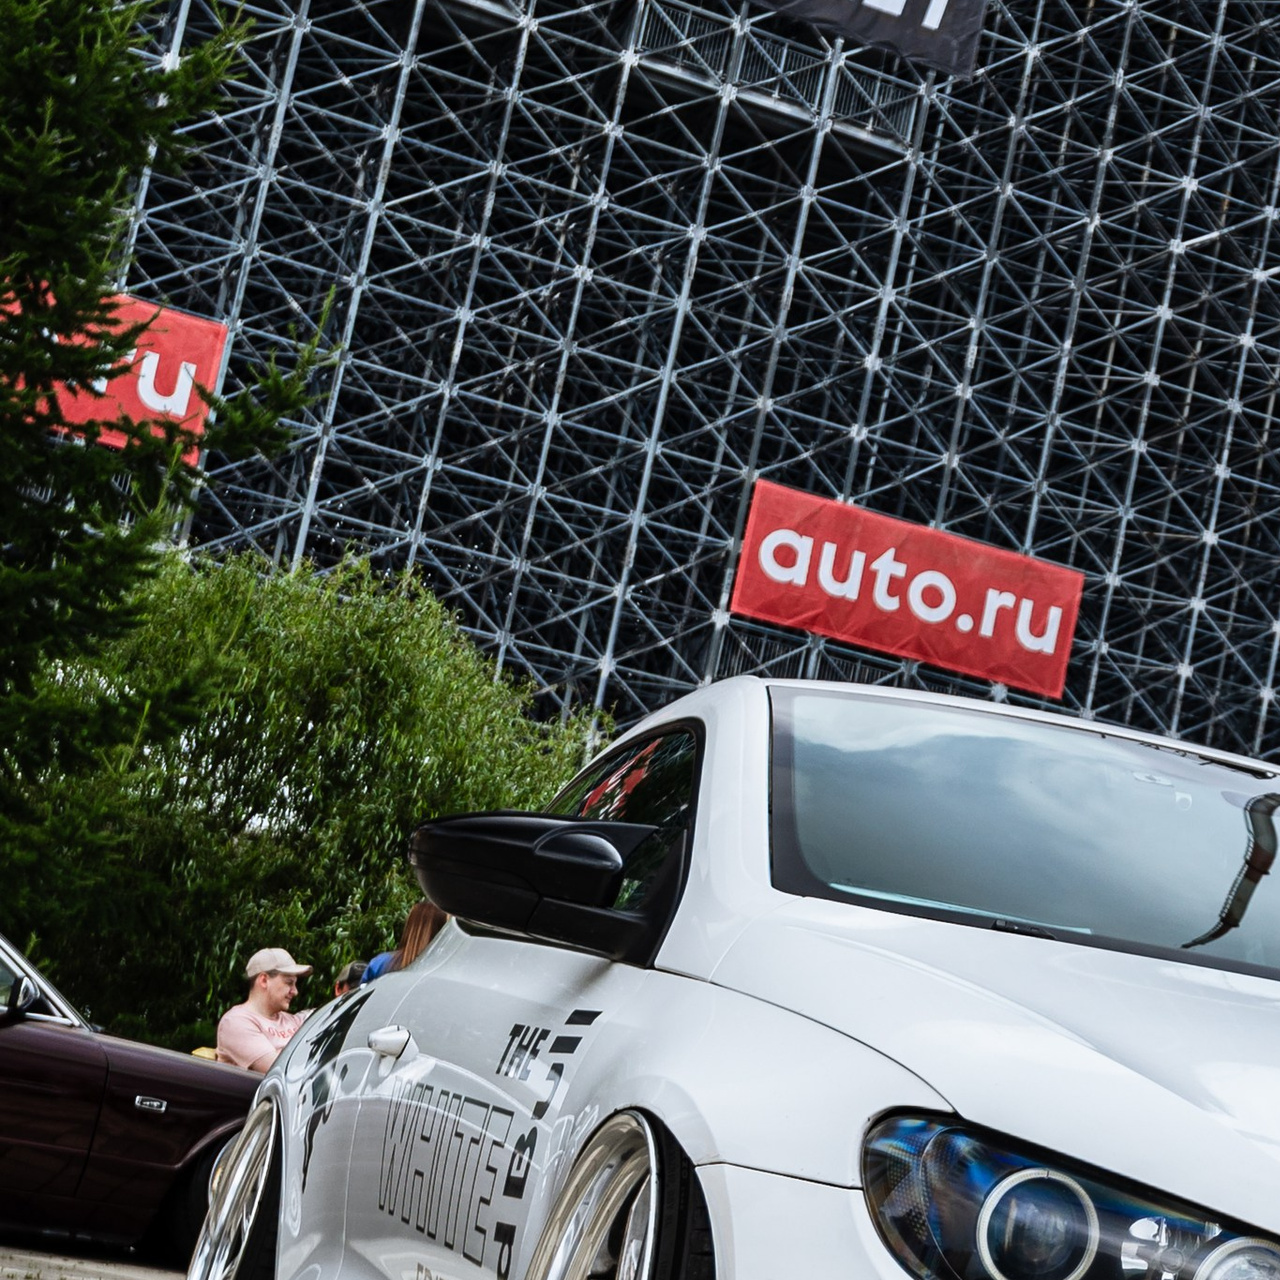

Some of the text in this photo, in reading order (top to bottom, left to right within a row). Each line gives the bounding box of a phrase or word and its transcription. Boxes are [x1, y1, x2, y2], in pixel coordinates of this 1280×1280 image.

[758, 528, 1063, 655] auto.ru
[495, 1023, 551, 1081] THE
[378, 1075, 515, 1268] WHITE
